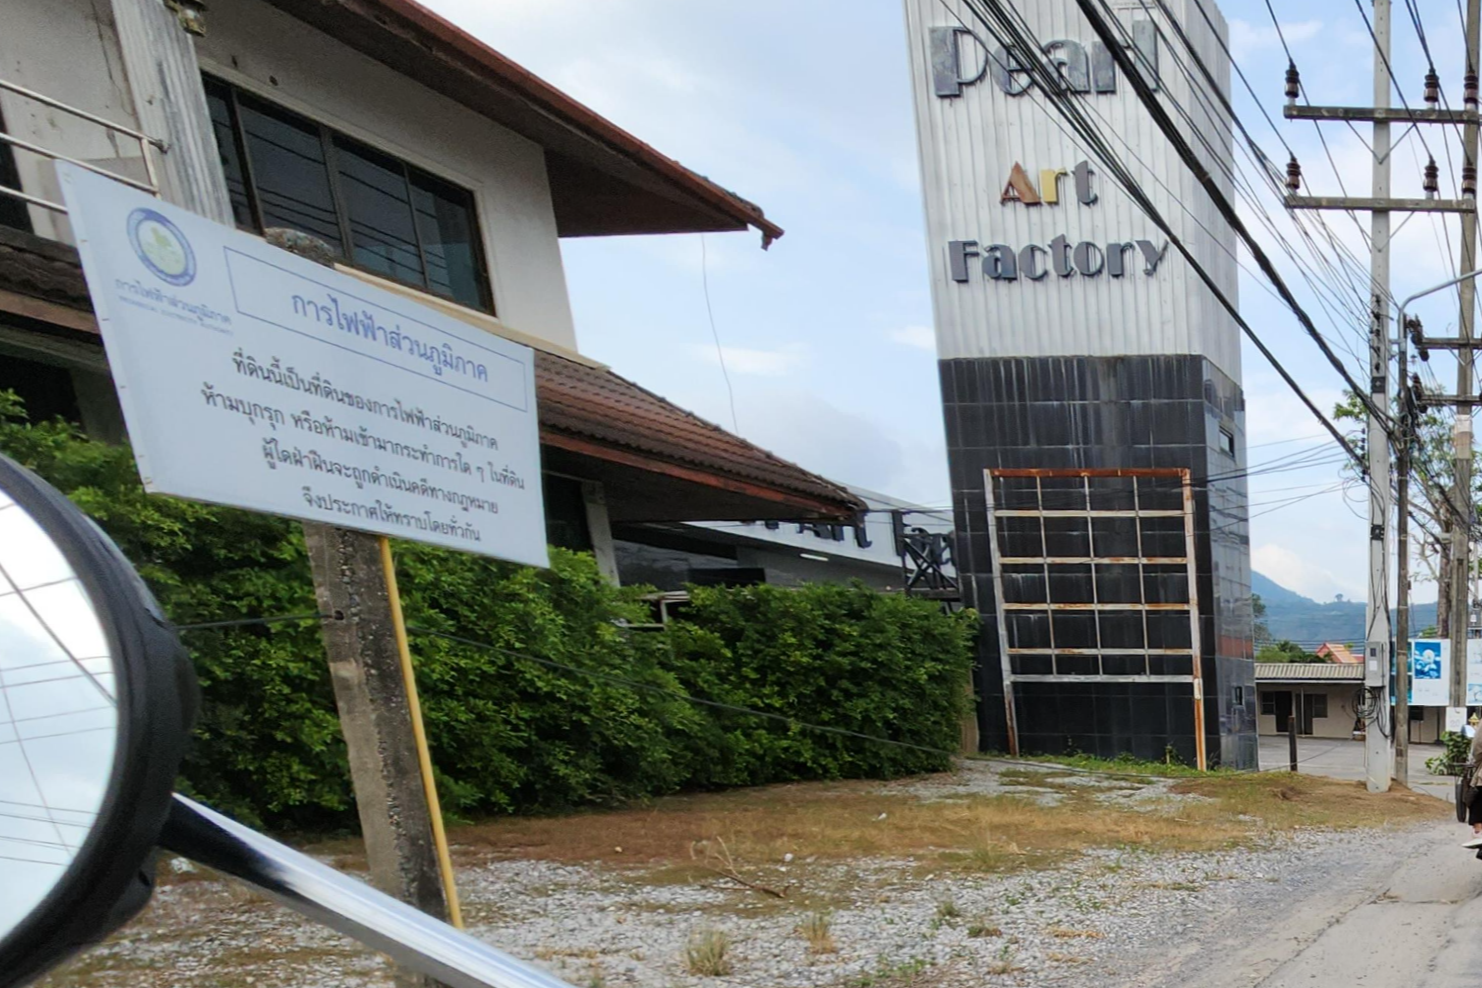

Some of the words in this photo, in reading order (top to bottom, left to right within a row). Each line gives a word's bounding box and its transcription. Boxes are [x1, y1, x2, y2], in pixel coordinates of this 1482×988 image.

[1000, 160, 1098, 206] Art
[948, 233, 1168, 283] Factory
[291, 293, 489, 382] การไฟฟ้าส่วนภูมิภาค
[201, 381, 285, 431] ห้ามบุกรุก
